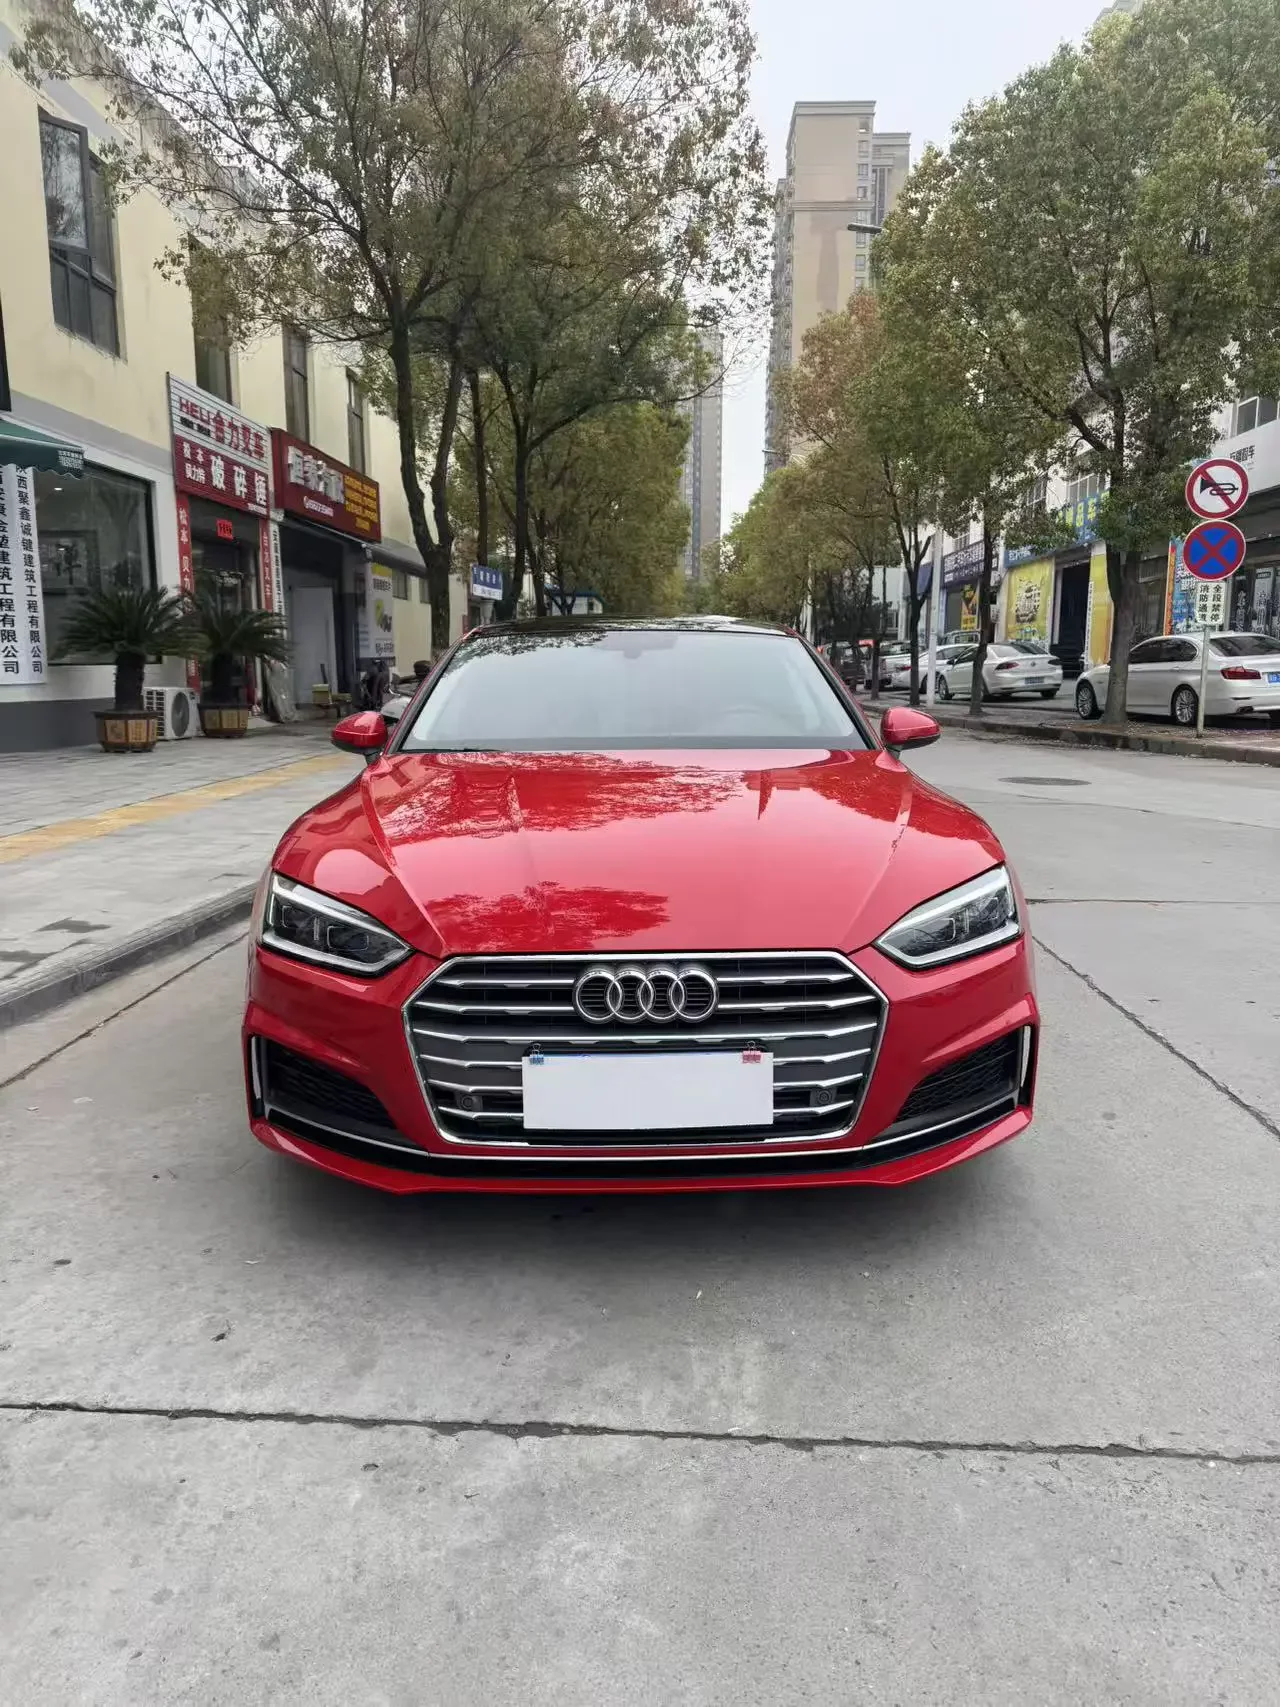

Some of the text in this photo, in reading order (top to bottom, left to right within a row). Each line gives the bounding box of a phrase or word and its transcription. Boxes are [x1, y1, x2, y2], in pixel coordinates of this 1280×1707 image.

[213, 410, 265, 459] 合力叉车
[1199, 584, 1210, 621] 消防通道
[1210, 584, 1222, 622] 全段禁停
